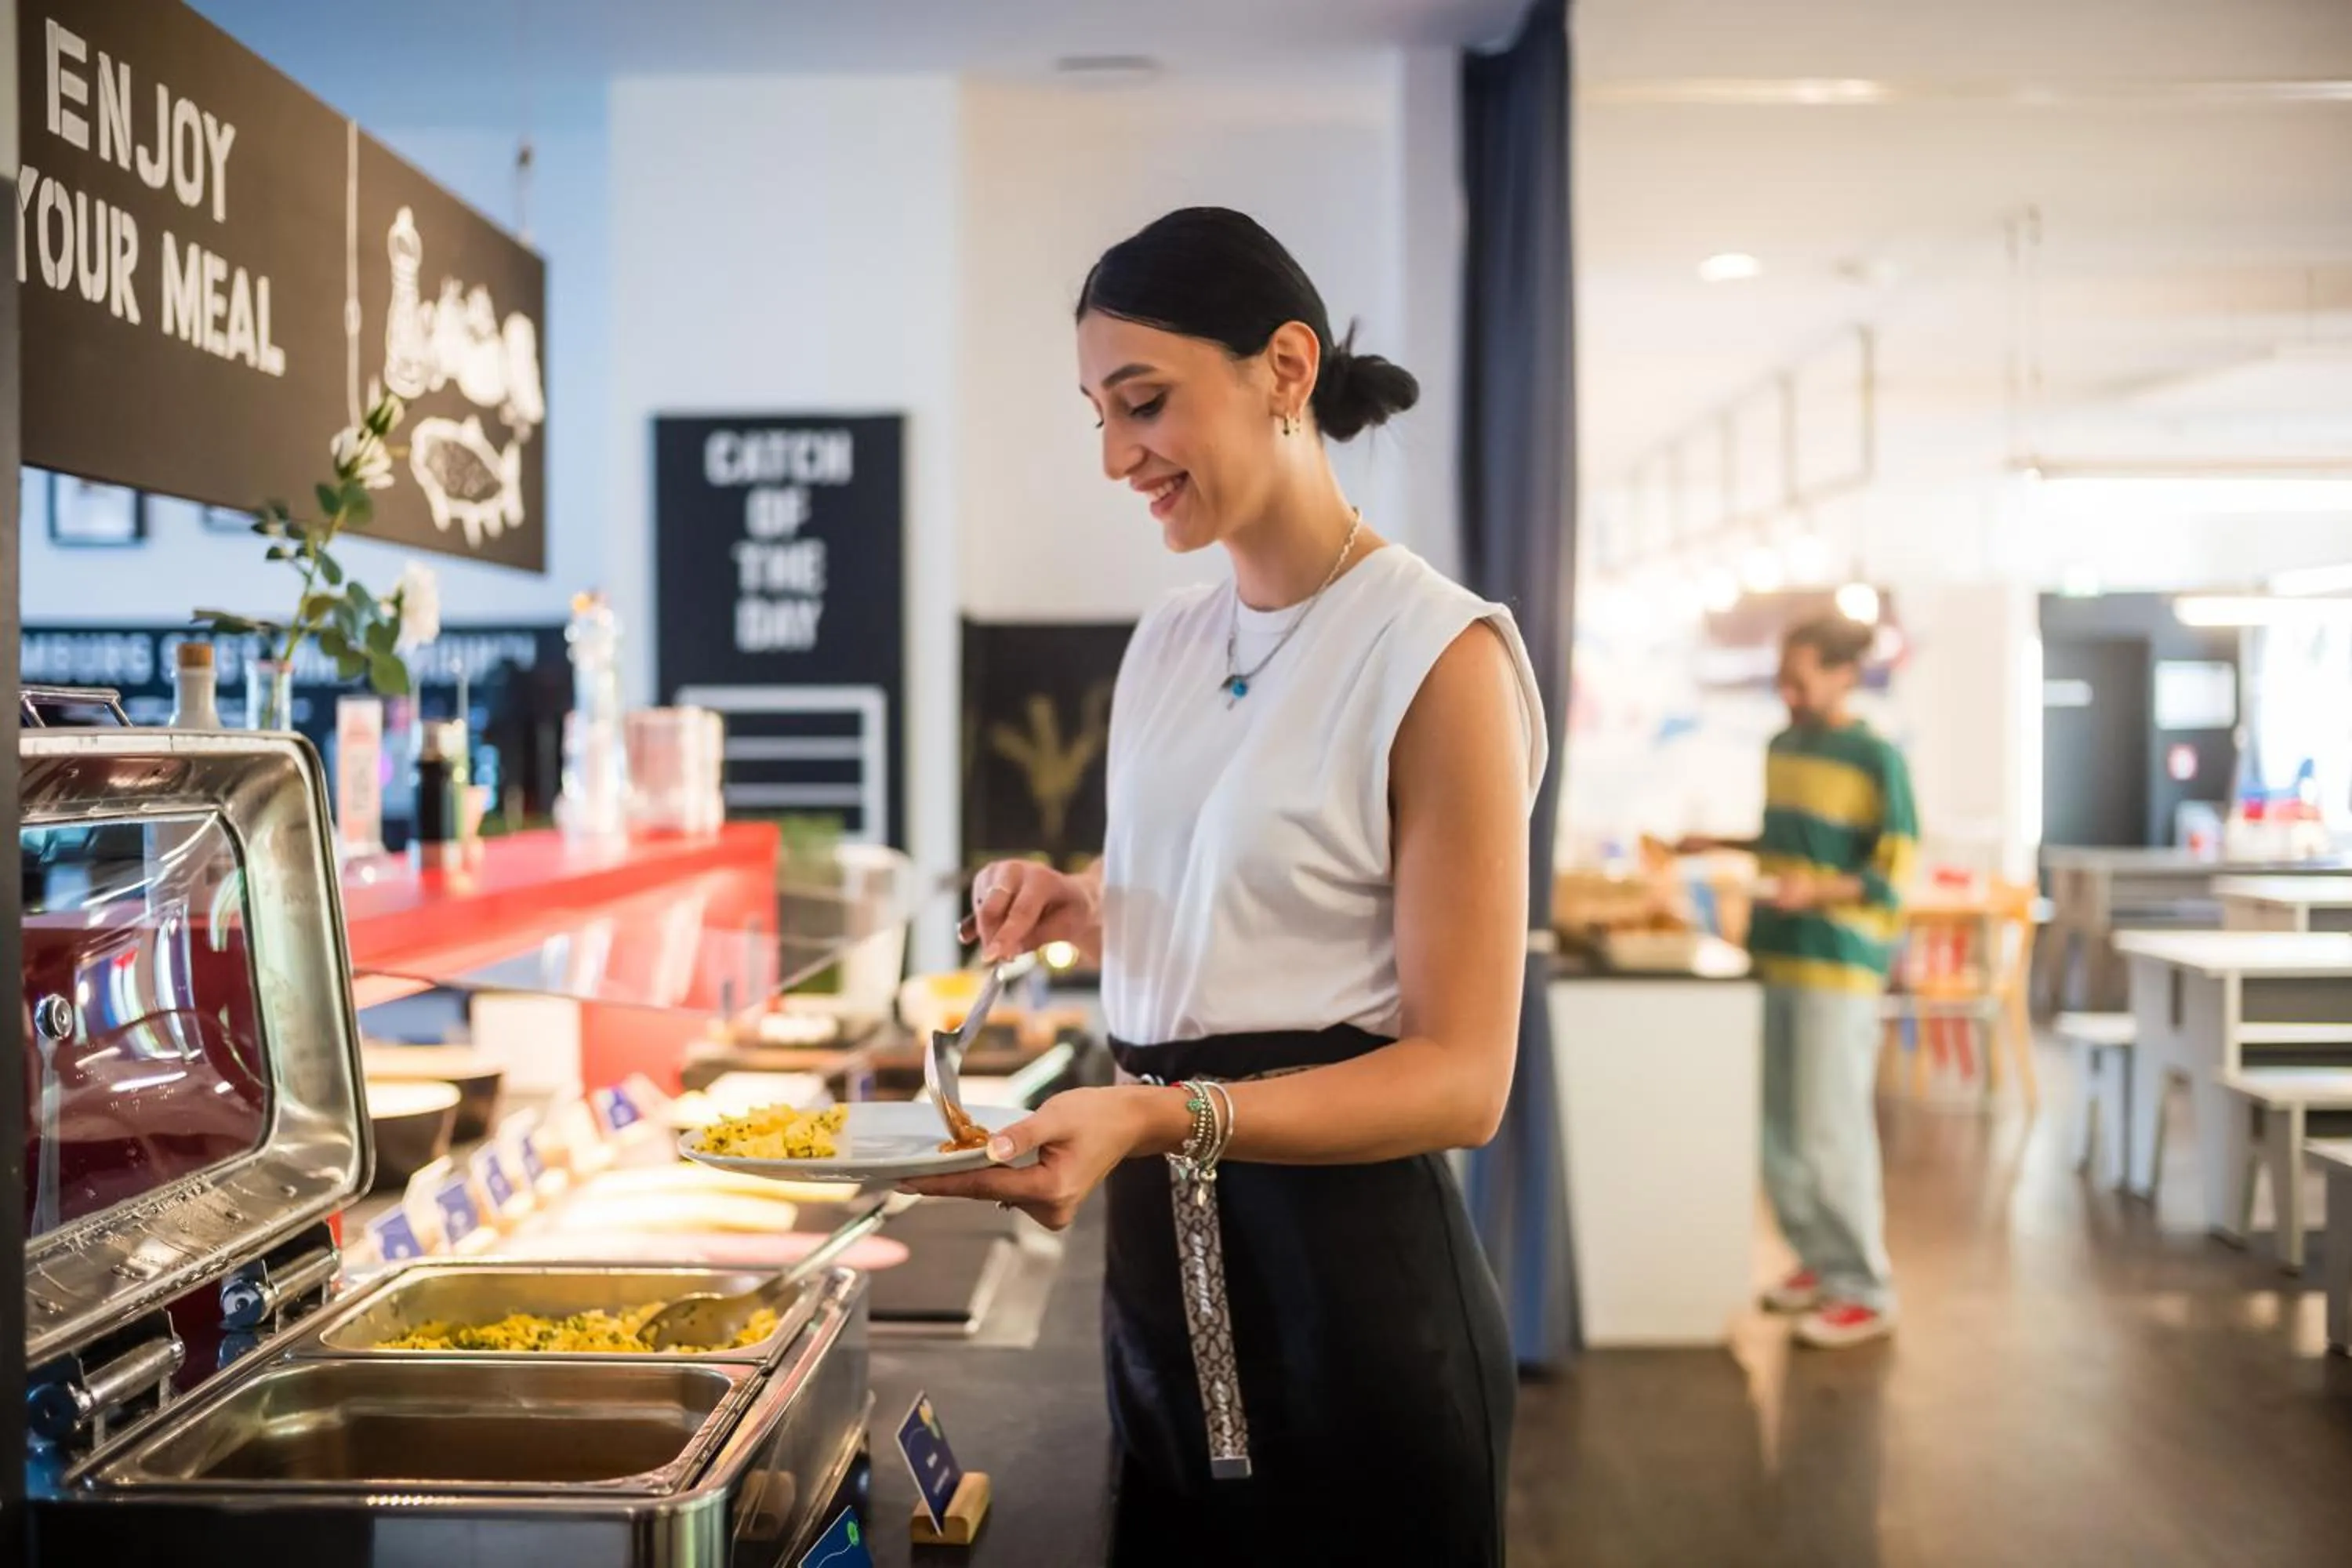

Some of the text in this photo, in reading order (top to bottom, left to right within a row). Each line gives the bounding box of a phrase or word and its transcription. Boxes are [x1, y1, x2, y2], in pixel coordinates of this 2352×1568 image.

[45, 17, 235, 223] ENJOY
[17, 165, 285, 376] YOUR MEAL
[704, 429, 853, 486] CATCH
[745, 486, 811, 537] OF
[731, 538, 826, 593] THE
[735, 595, 823, 652] DAY
